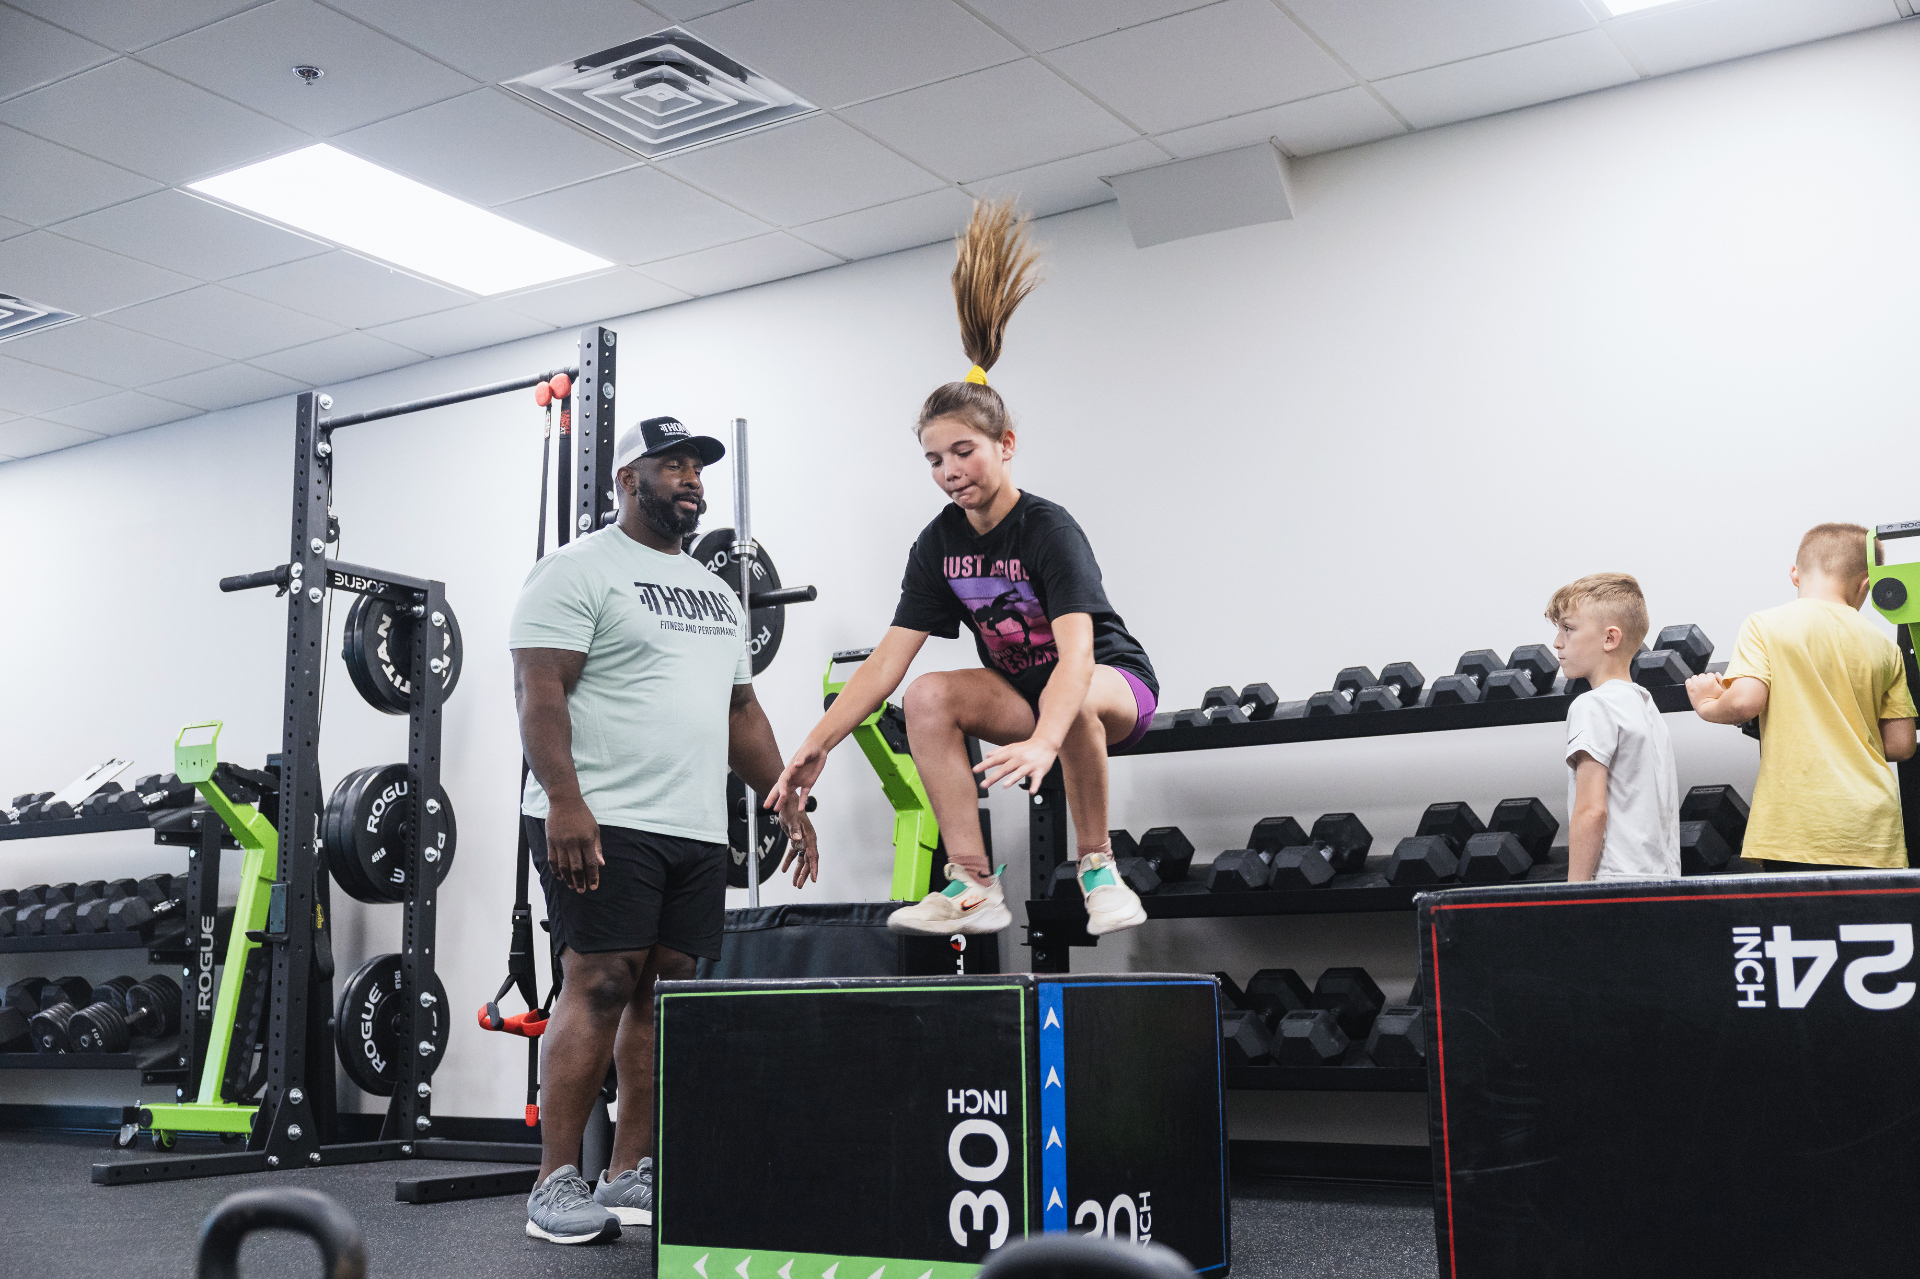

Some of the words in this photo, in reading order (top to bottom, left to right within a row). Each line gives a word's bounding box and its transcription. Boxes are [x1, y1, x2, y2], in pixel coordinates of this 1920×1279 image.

[633, 581, 738, 626] THOMAS
[660, 620, 685, 632] FITNESS
[685, 623, 697, 634] AND
[366, 780, 408, 834] ROGU
[371, 847, 387, 863] 45LB
[198, 916, 214, 1011] ROGUE
[1732, 926, 1766, 1008] INCH
[1764, 923, 1916, 1011] 24
[361, 983, 387, 1074] ROGUE
[947, 1089, 1007, 1115] INCH
[948, 1119, 1010, 1250] 30
[1139, 1191, 1152, 1249] NCH
